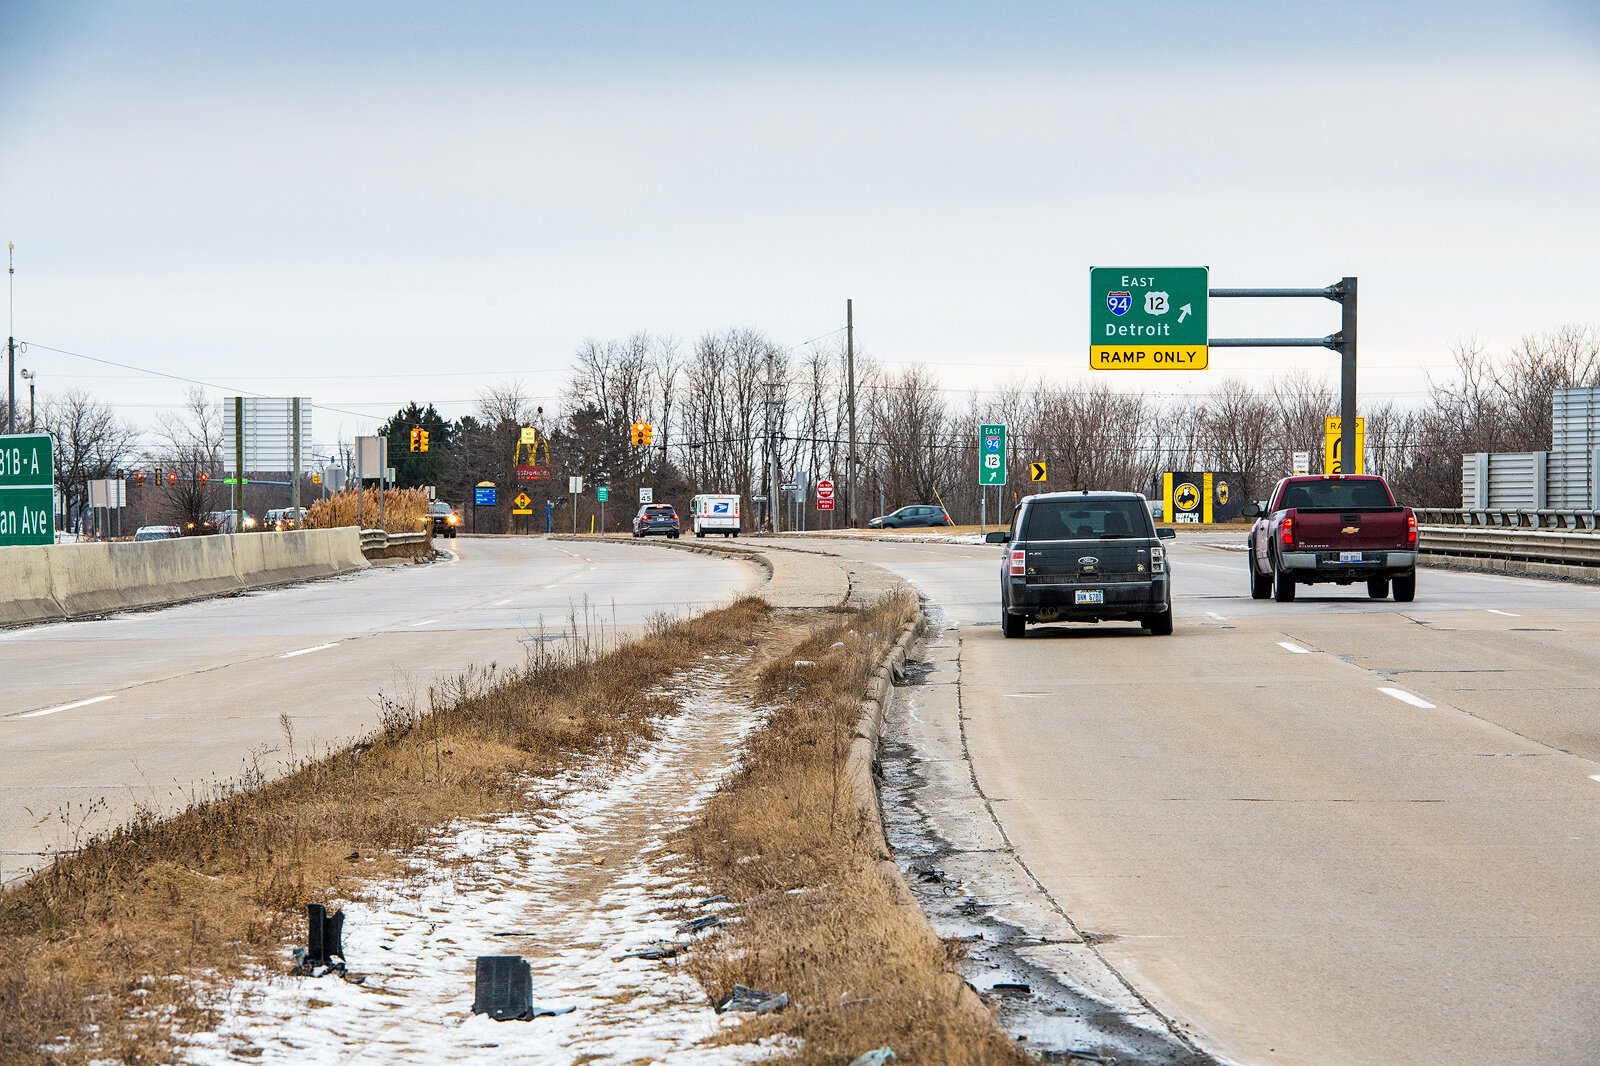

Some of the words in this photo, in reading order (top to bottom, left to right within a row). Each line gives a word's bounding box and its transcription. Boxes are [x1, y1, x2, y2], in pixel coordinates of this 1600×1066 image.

[1121, 275, 1155, 287] EAST
[1108, 298, 1128, 311] 94
[1149, 297, 1164, 310] 12
[1105, 323, 1170, 336] Detroit
[1100, 351, 1146, 363] RAMP
[1153, 351, 1197, 363] ONLY
[985, 427, 1001, 435] EAST
[986, 440, 999, 449] 94
[988, 456, 998, 466] 12
[21, 505, 47, 535] Ave
